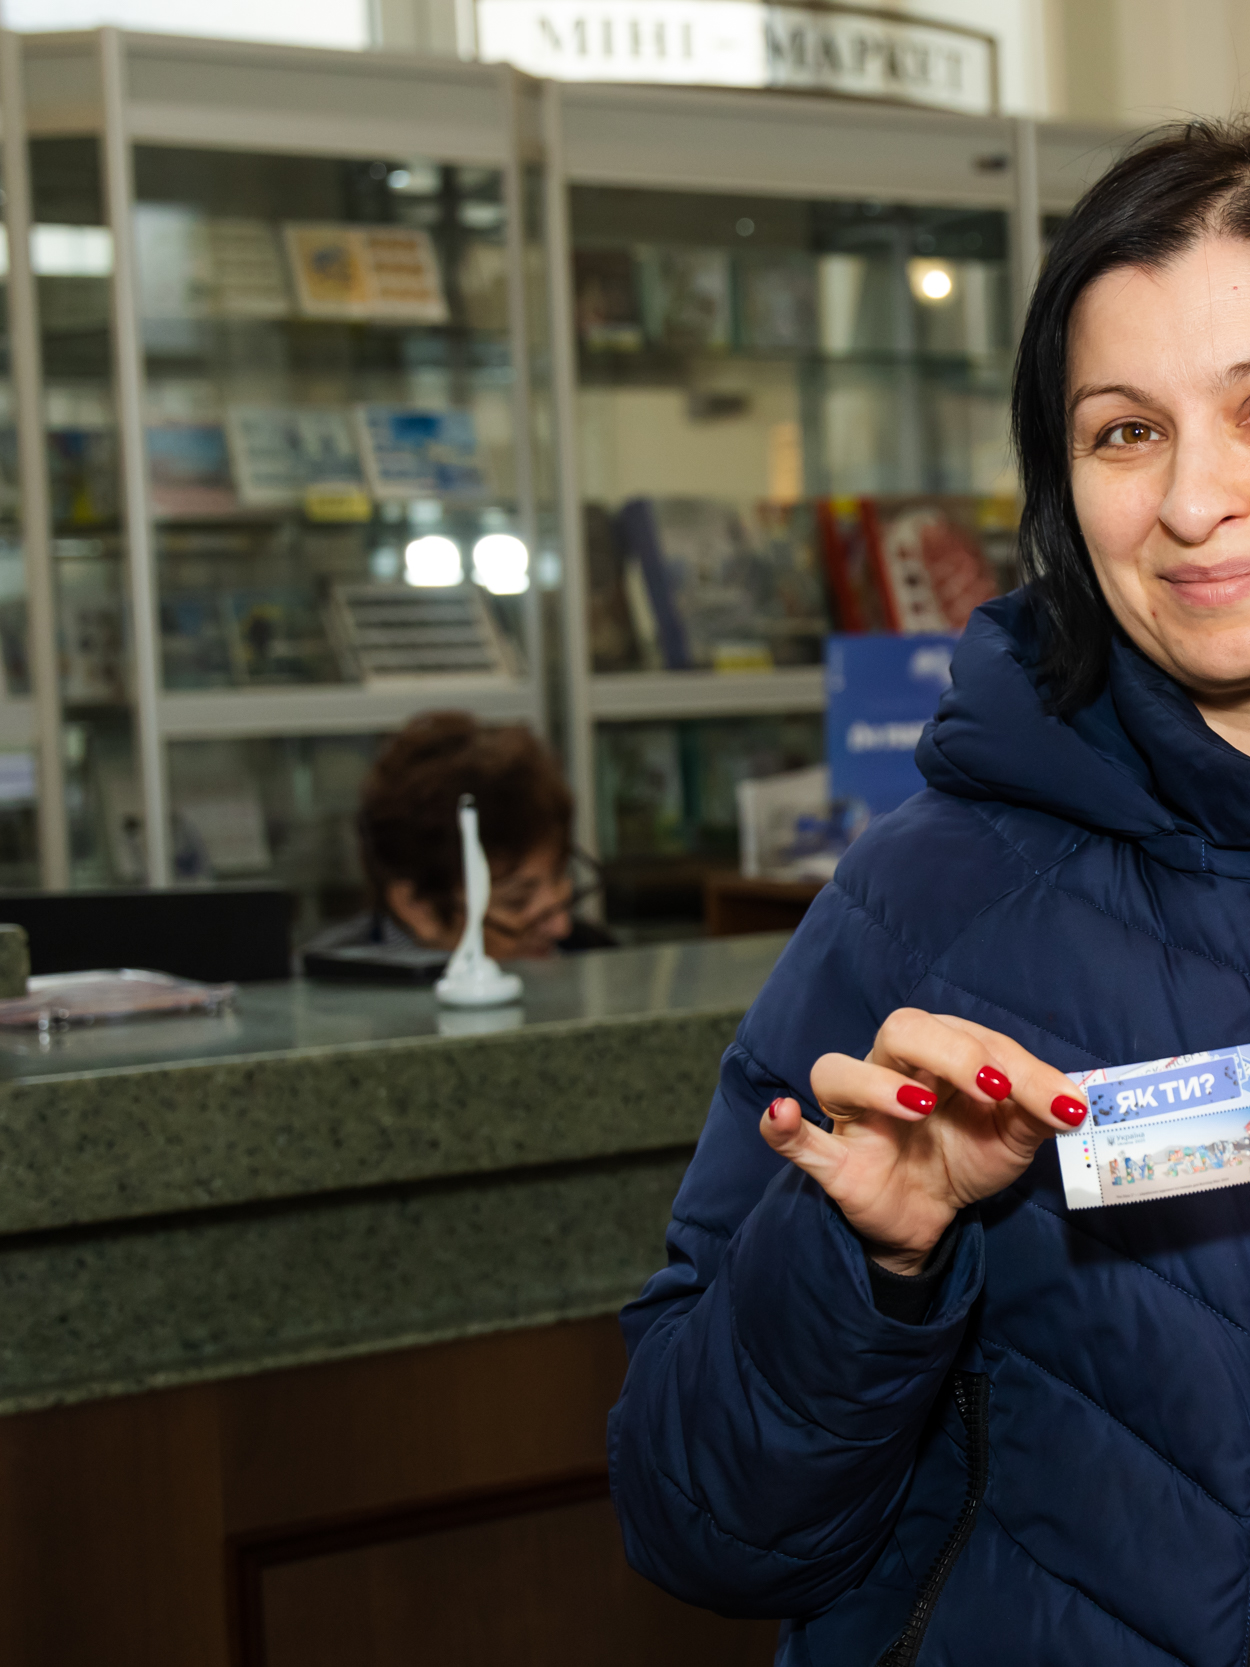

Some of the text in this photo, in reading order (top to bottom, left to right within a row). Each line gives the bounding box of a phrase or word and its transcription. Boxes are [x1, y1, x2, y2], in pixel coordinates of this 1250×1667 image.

[536, 14, 693, 61] МІНІ
[764, 15, 971, 93] МАРКЕТ
[1116, 1073, 1215, 1114] ЯК ТИ?
